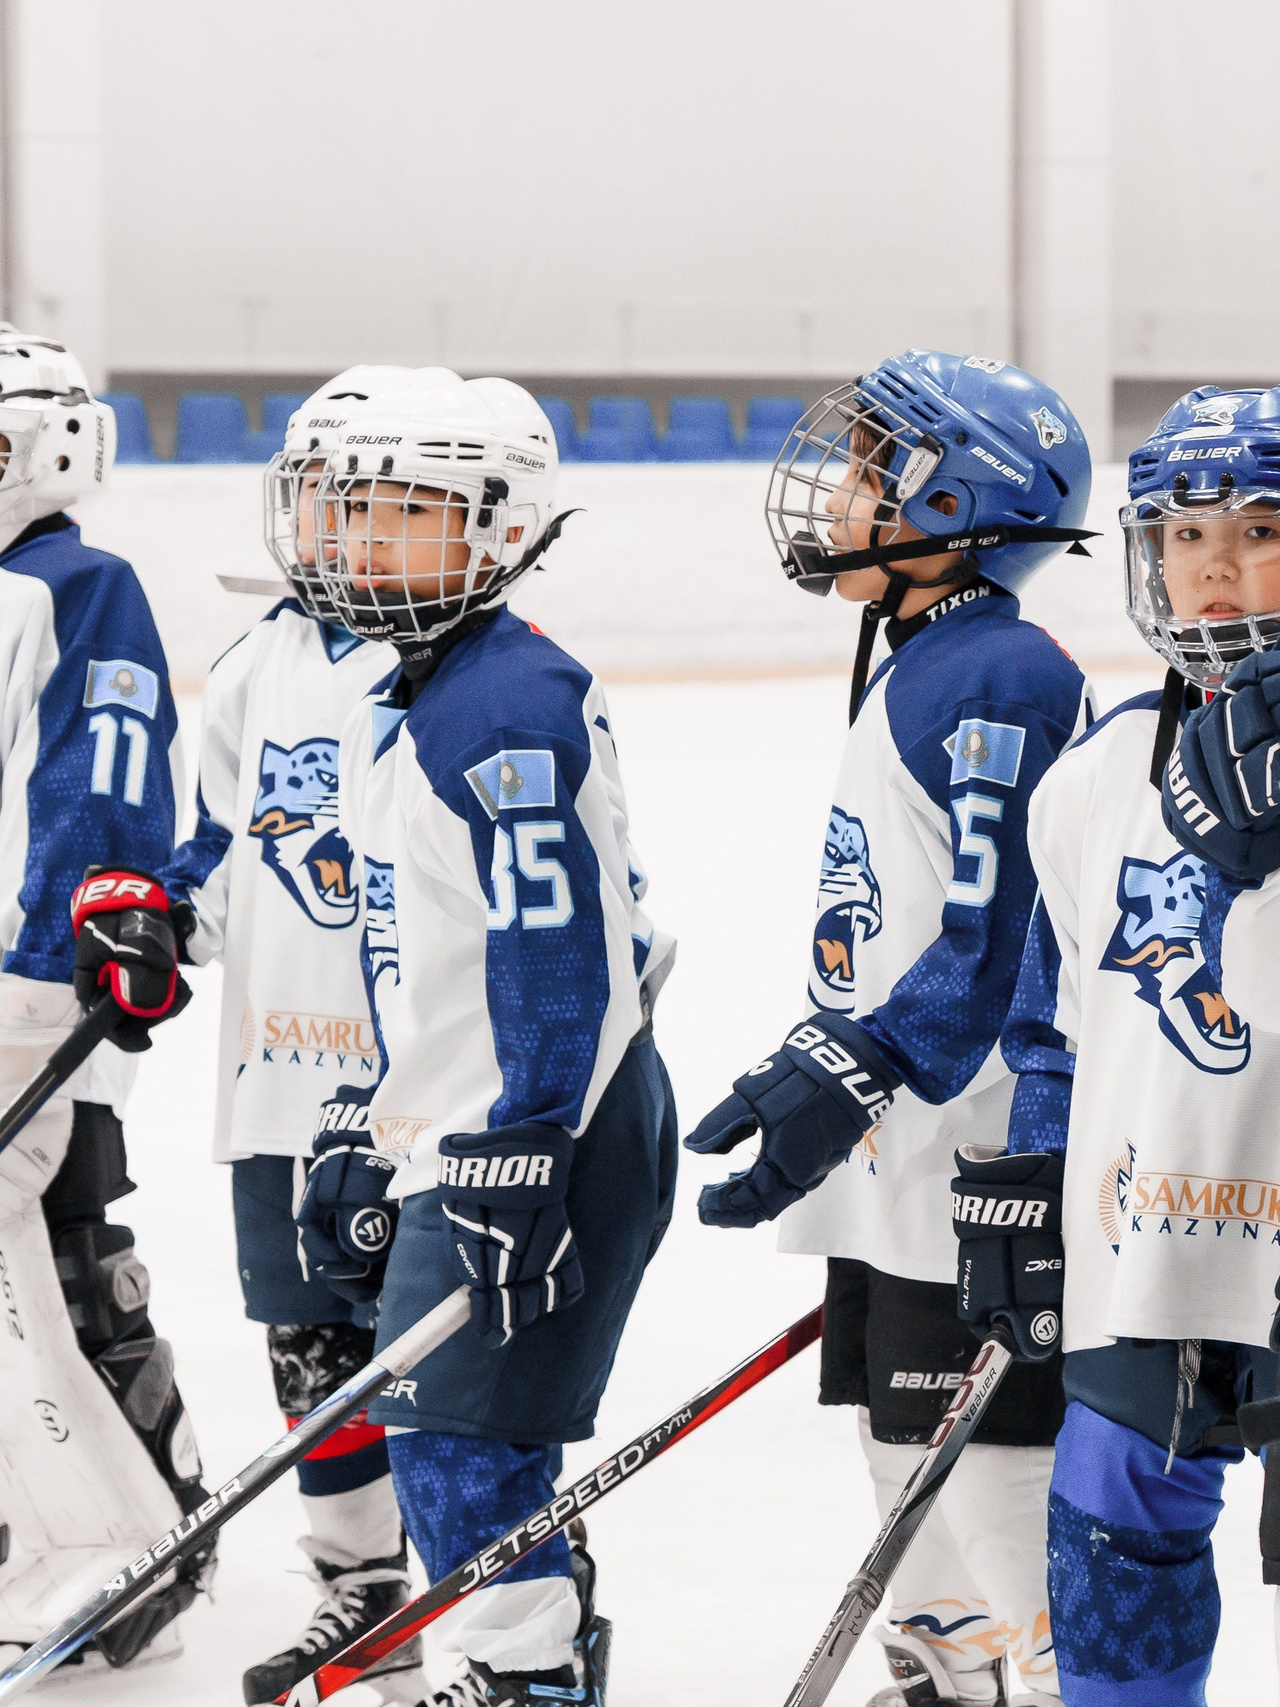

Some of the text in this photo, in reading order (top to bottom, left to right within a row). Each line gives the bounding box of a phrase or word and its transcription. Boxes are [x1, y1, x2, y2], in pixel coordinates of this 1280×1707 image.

[307, 418, 347, 429] BAU
[346, 435, 402, 446] BAUER
[505, 453, 546, 471] BAUER
[970, 445, 1026, 485] BAUER
[1167, 446, 1242, 462] BAUER
[88, 711, 149, 807] 11
[945, 792, 1005, 908] 5
[264, 1015, 376, 1053] SAMRU
[263, 1048, 374, 1073] KAZYN
[785, 1024, 892, 1123] BAUE
[437, 1154, 554, 1188] RRIOR
[951, 1191, 1048, 1228] RRIOR
[456, 1243, 478, 1279] COVERT
[962, 1259, 972, 1310] ALPHA
[889, 1371, 966, 1390] BAUE
[969, 1366, 997, 1418] BAUER
[128, 1478, 245, 1580] BAUER
[459, 1445, 646, 1593] JETSPEED
